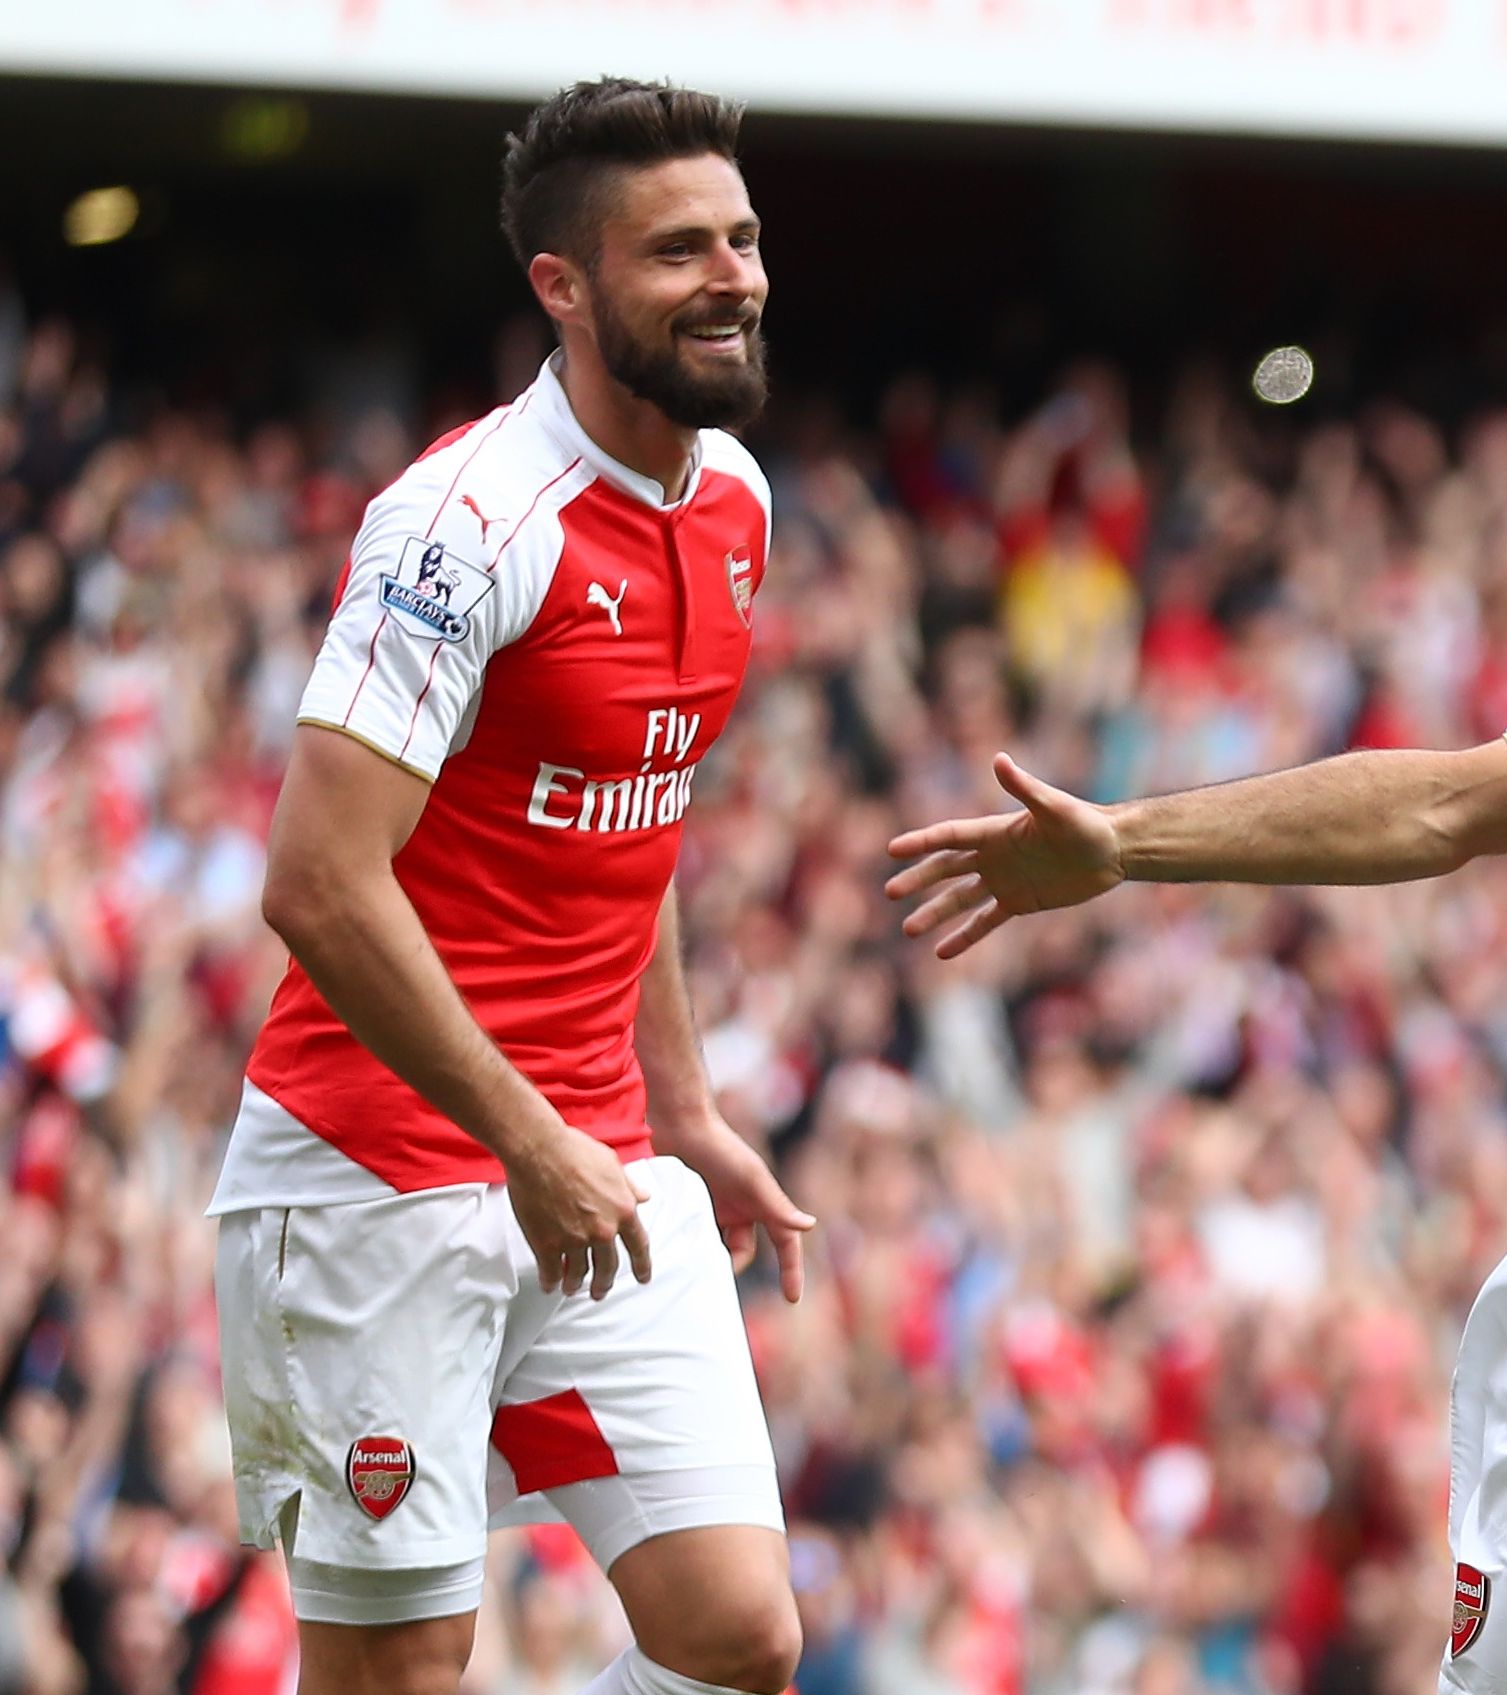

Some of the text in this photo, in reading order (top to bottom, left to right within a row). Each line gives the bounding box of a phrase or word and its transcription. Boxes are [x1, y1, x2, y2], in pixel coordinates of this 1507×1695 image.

[386, 586, 446, 623] BARCLAYS
[643, 707, 700, 763] Fly
[354, 1449, 406, 1464] Arsenal
